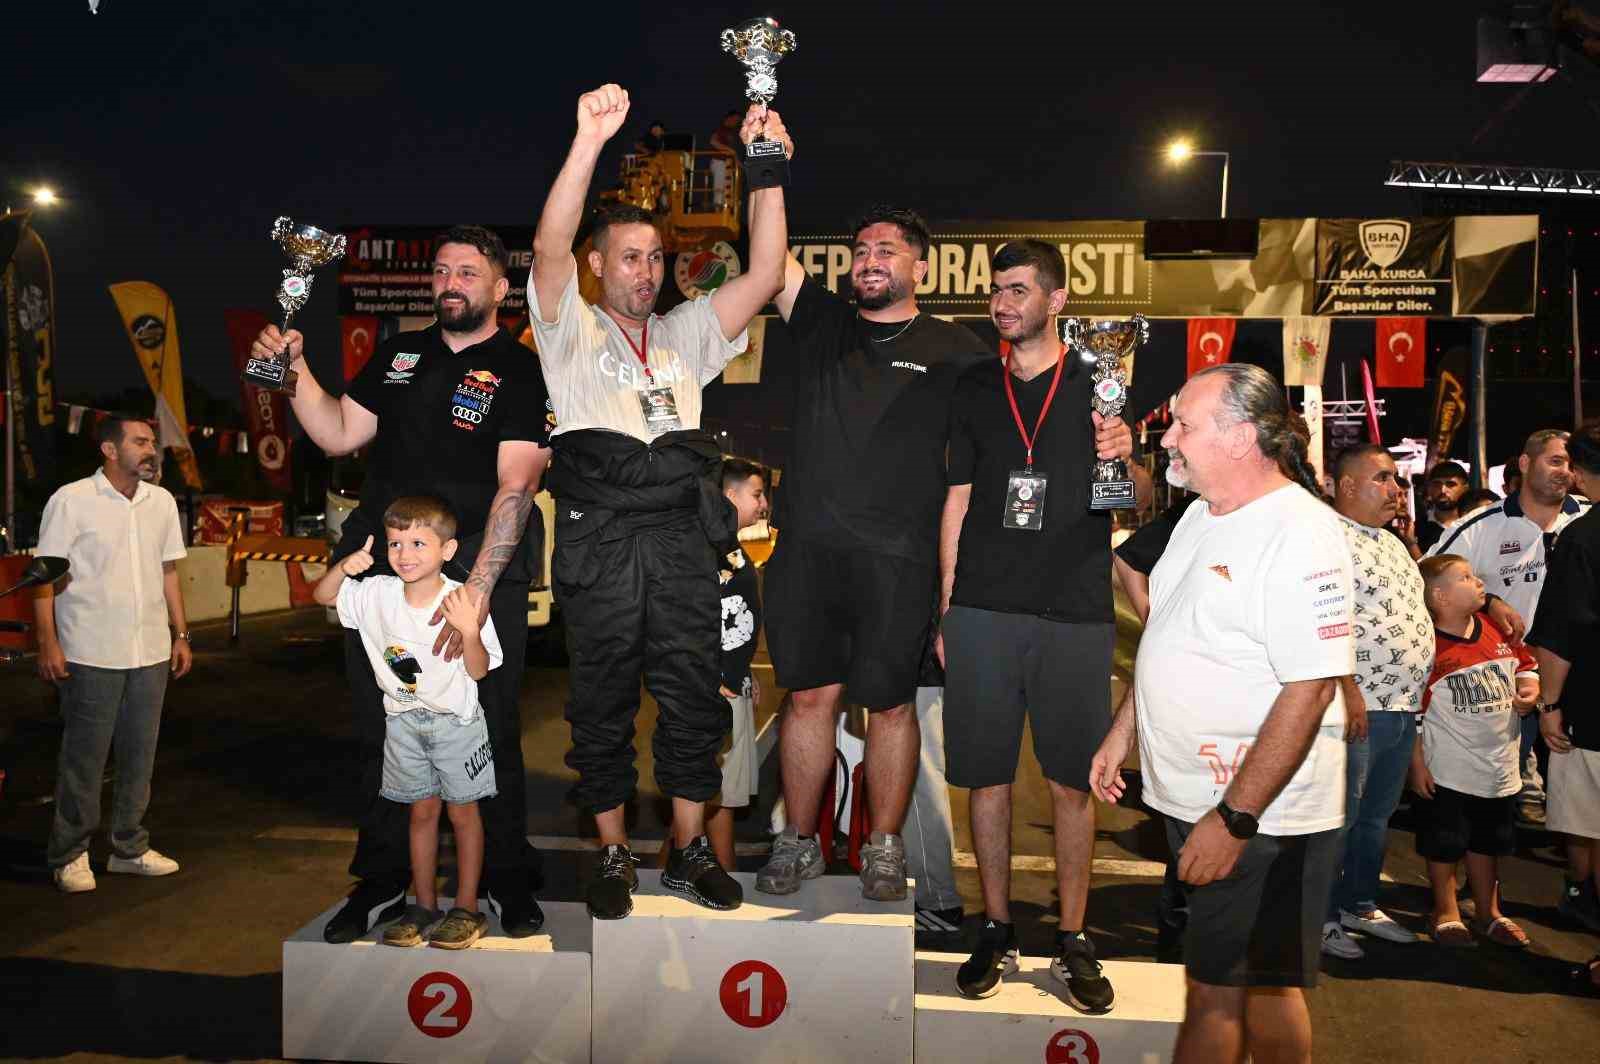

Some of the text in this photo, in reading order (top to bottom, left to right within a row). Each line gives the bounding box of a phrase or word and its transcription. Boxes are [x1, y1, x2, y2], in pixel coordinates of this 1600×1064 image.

[1368, 232, 1400, 242] BHA
[914, 242, 1008, 295] DRA
[1340, 269, 1377, 279] BAHA
[352, 287, 433, 299] Tüm Sporcula
[1332, 285, 1436, 297] Tüm Sporculara
[1334, 301, 1432, 313] Başarılar Diler.
[1454, 703, 1511, 714] MUSTA
[736, 971, 763, 1017] 1
[422, 982, 458, 1028] 2
[1056, 1035, 1088, 1064] 3
